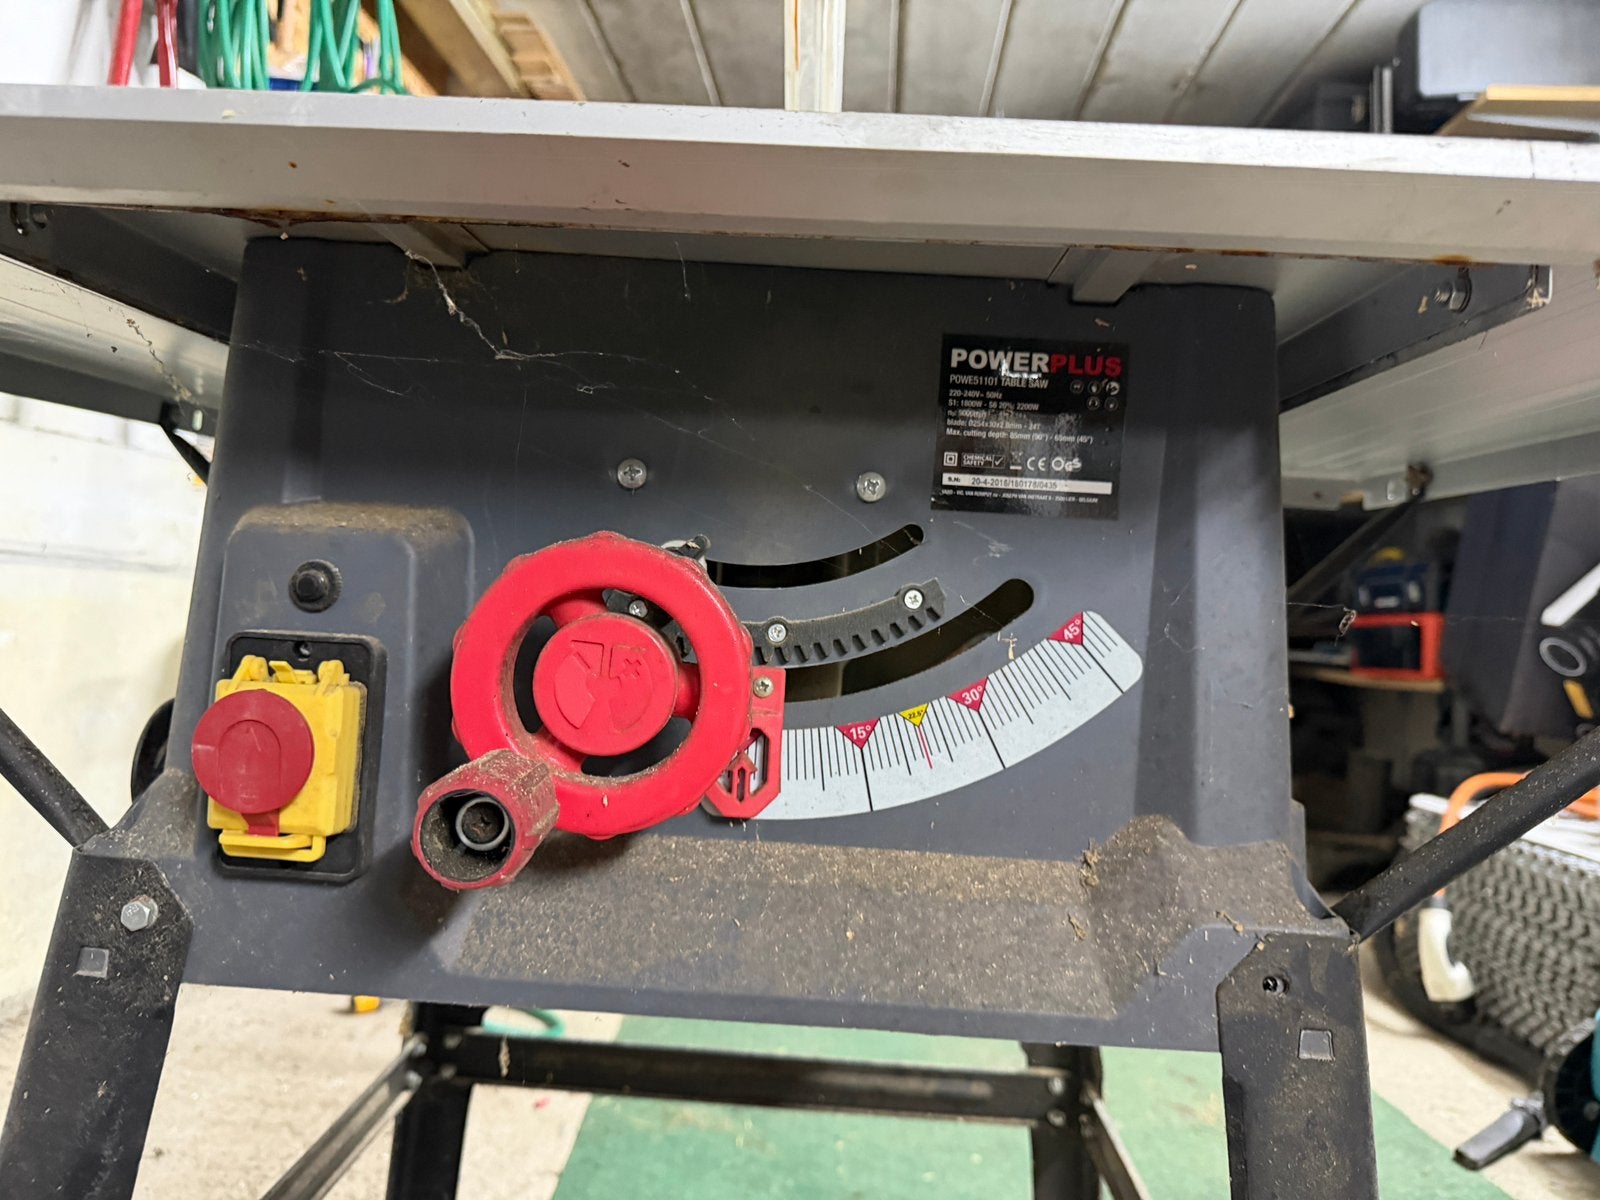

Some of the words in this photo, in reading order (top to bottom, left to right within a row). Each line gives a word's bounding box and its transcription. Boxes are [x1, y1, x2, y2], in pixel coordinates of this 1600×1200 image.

[950, 348, 1122, 377] POWERPLUS
[949, 374, 998, 387] POWE51101
[1001, 376, 1027, 388] TABLE
[1028, 377, 1049, 389] SAW
[963, 454, 993, 462] CHEMICAL
[1062, 618, 1082, 641] 45°
[961, 685, 983, 705] 30°
[849, 725, 872, 740] 15°
